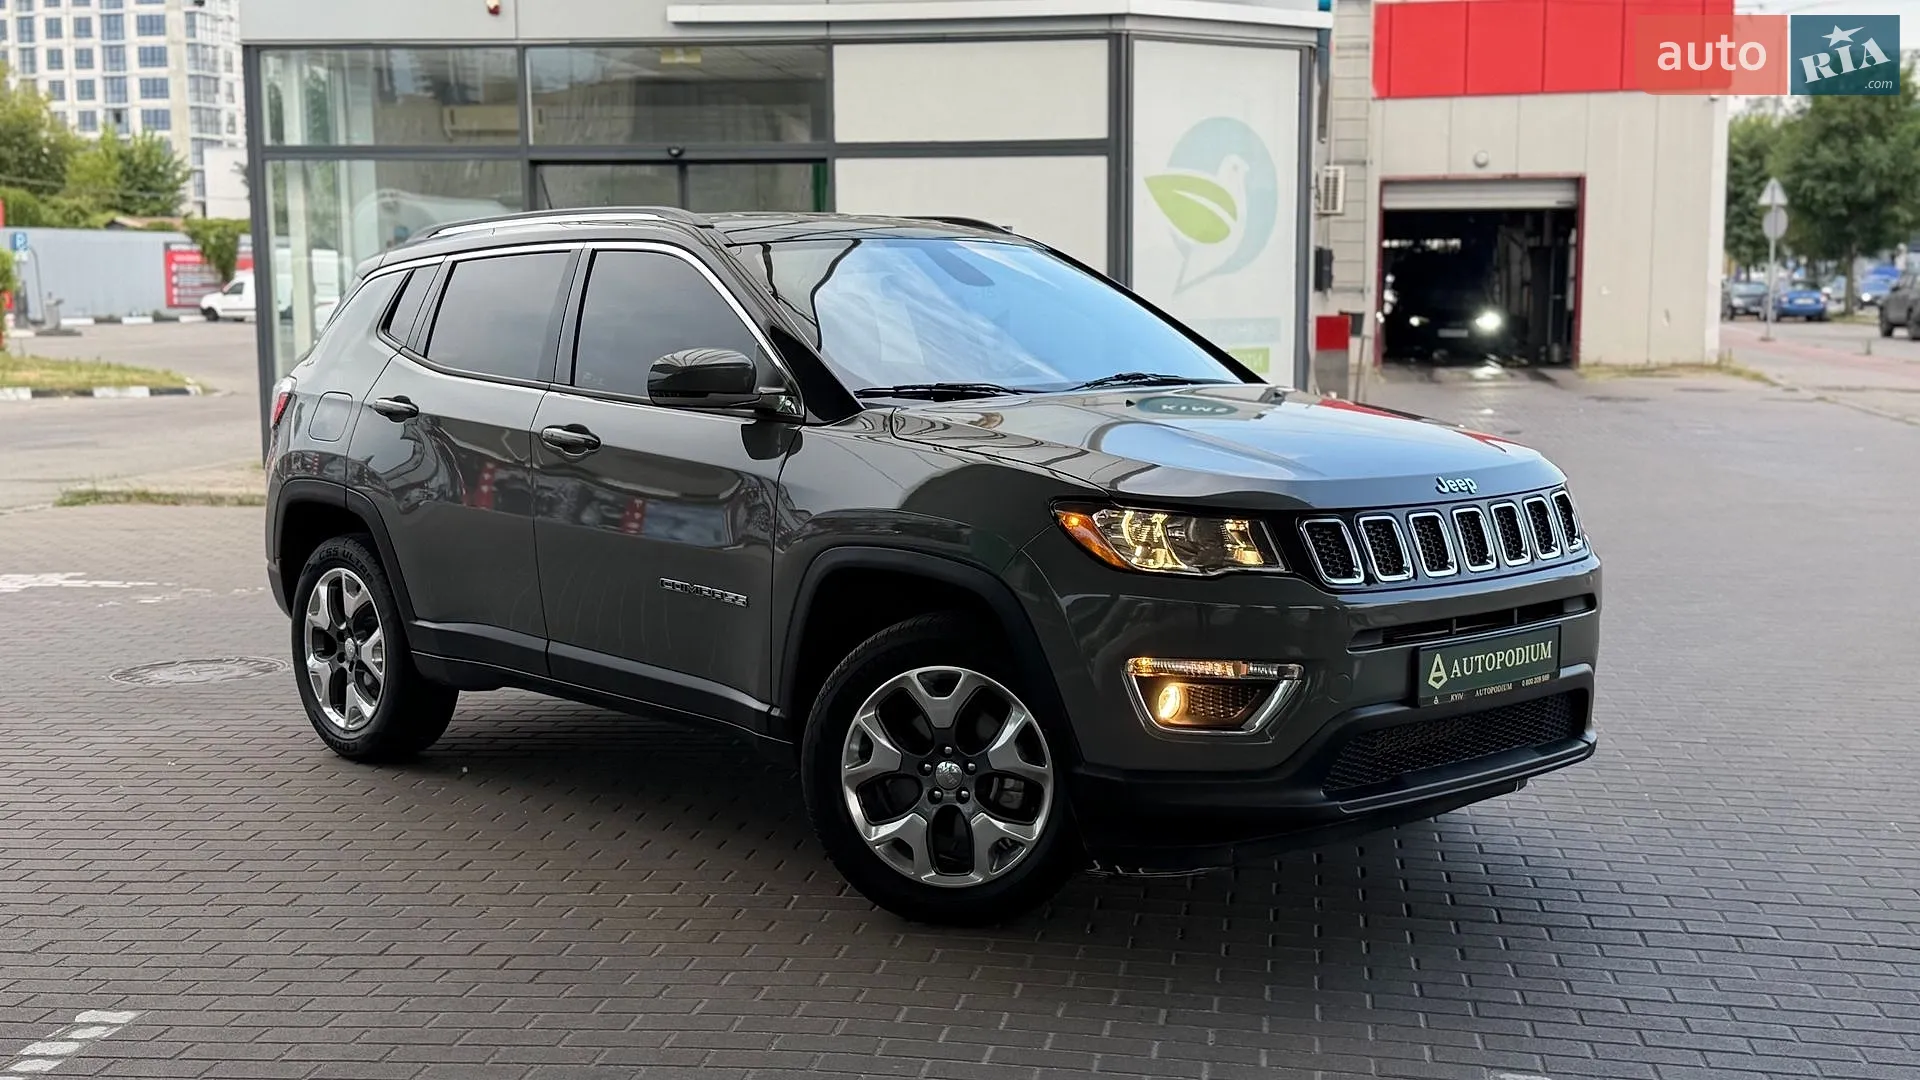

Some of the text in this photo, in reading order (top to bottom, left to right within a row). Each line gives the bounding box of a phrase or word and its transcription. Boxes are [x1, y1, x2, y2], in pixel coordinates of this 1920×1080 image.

[1435, 476, 1478, 495] Jeep
[660, 577, 748, 607] COMPASS
[1450, 641, 1553, 678] AUTOPODIUM
[1474, 683, 1513, 697] AUTOPODIUM
